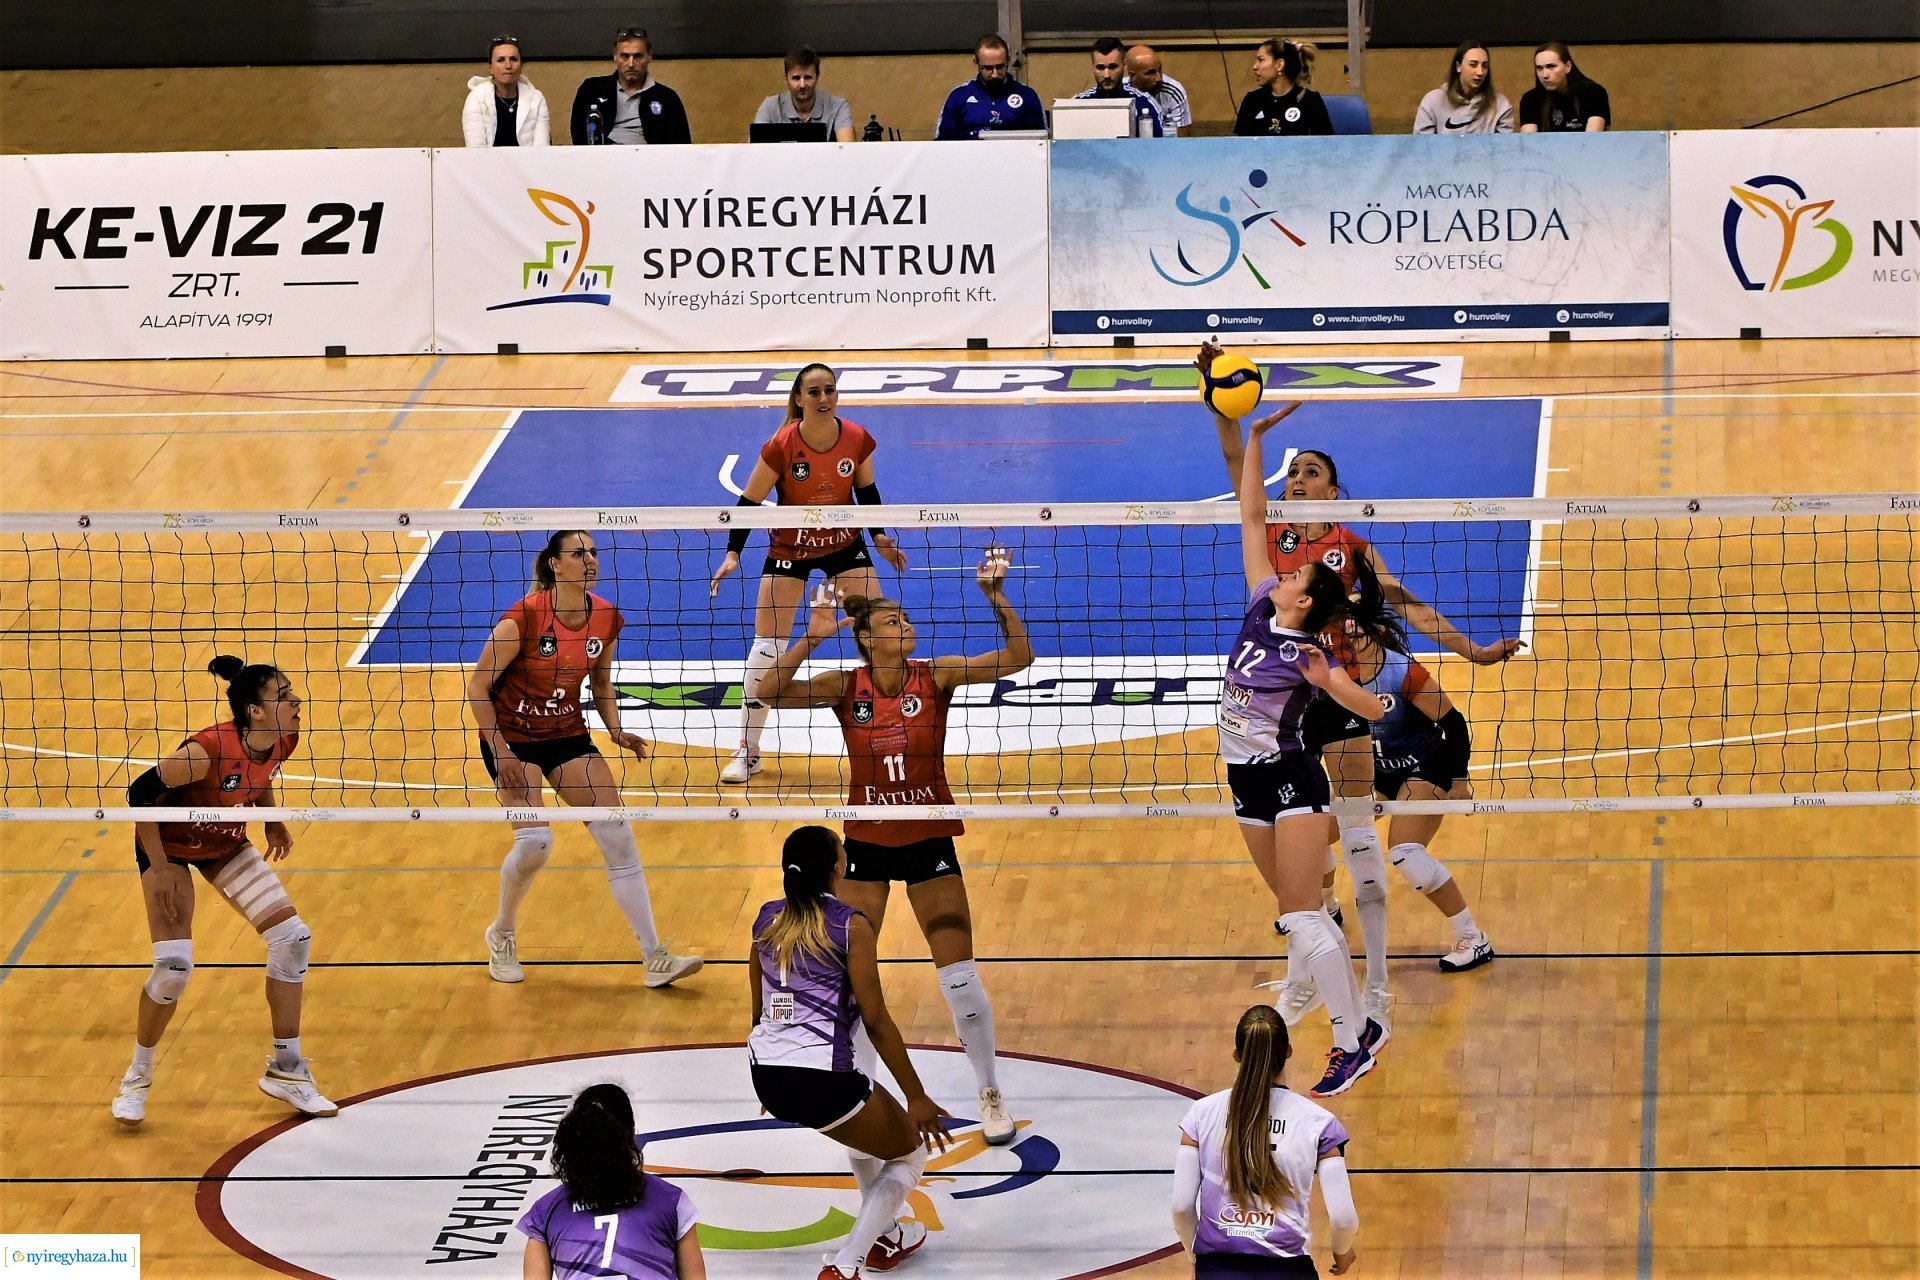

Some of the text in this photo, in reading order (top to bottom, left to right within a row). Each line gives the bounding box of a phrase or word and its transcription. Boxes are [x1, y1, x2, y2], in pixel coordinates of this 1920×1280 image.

[1405, 183, 1489, 199] MAGYAR
[643, 187, 928, 229] NYÍREGYHÁZI
[28, 201, 385, 260] KE-VIZ 21
[1329, 202, 1570, 245] RÖPLABDA
[643, 243, 996, 280] SPORTCENTRUM
[1394, 250, 1503, 271] SZÖVETSÉG
[167, 271, 241, 298] ZRT.
[643, 285, 997, 311] Nyíregyházi Sportcentrum Nonprofit Kft.
[140, 310, 274, 329] ALAPÍTVA 1991
[1111, 317, 1154, 327] hunvolley
[1221, 316, 1264, 326] hunvolley
[1327, 313, 1405, 324] www.hunvolley.hu
[1469, 312, 1511, 322] hunvolley
[1572, 310, 1614, 321] hunvolley
[918, 510, 960, 521] FATUM
[1566, 502, 1607, 514] FATUM
[278, 514, 319, 526] FATUM
[598, 512, 638, 523] FATUM
[795, 528, 853, 548] FATUM
[1233, 641, 1267, 678] 12
[553, 689, 566, 707] 2
[883, 754, 906, 782] 11
[865, 785, 935, 805] FATUM
[1793, 796, 1825, 806] FATUM
[189, 810, 221, 821] FATUM
[506, 810, 538, 820] FATUM
[825, 808, 858, 818] FATUM
[1146, 805, 1179, 816] FATUM
[1473, 803, 1505, 813] FATUM
[1219, 1203, 1276, 1228] Capri
[594, 1213, 619, 1268] 7
